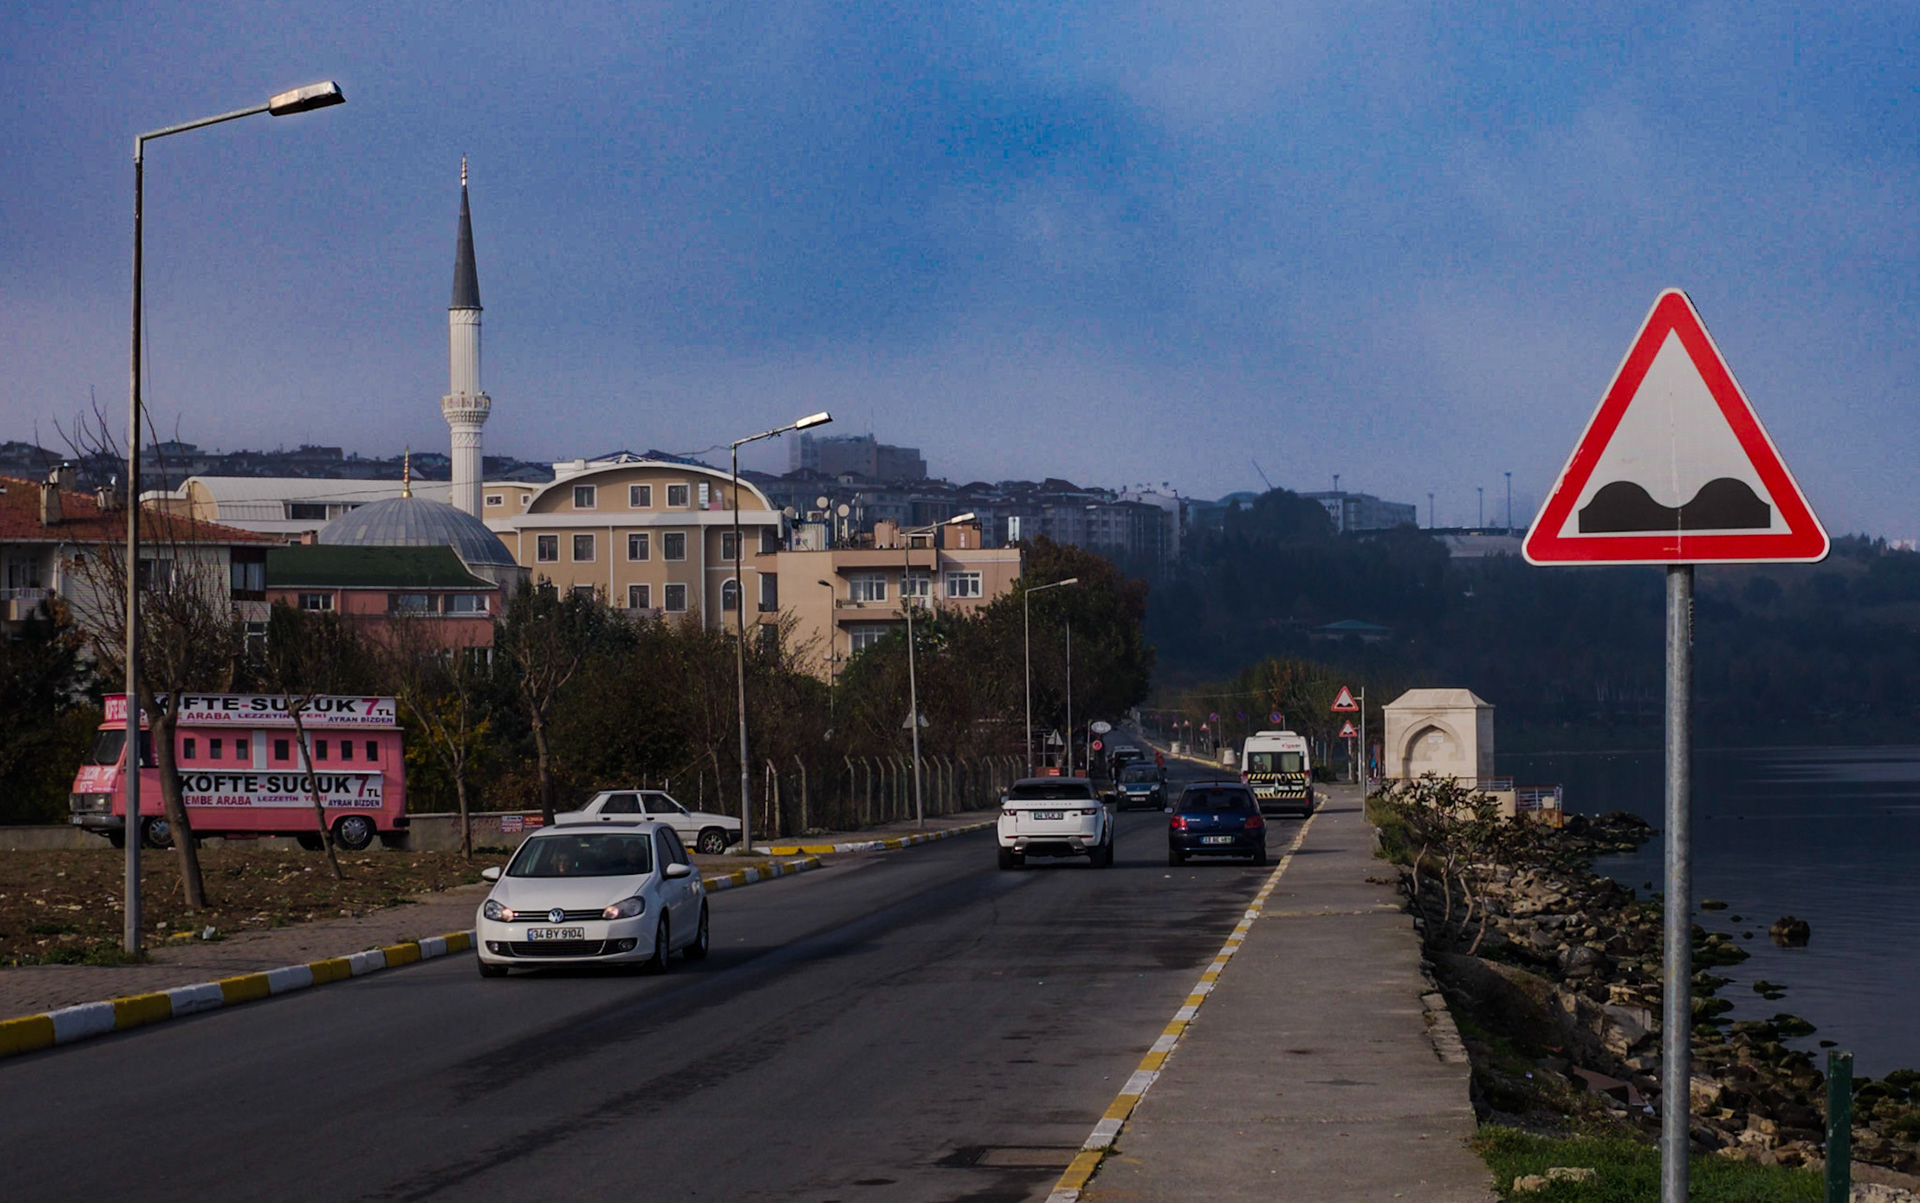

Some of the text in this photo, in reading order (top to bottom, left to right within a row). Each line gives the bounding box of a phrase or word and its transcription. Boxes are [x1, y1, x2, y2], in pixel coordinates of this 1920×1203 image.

[361, 697, 380, 716] 7
[187, 711, 232, 720] ARABA
[355, 775, 370, 798] 7
[367, 788, 380, 797] TL
[185, 795, 214, 805] EMBE
[216, 795, 252, 805] ARABA
[328, 799, 352, 807] AYRAN
[533, 928, 582, 939] 34 BY 9104
